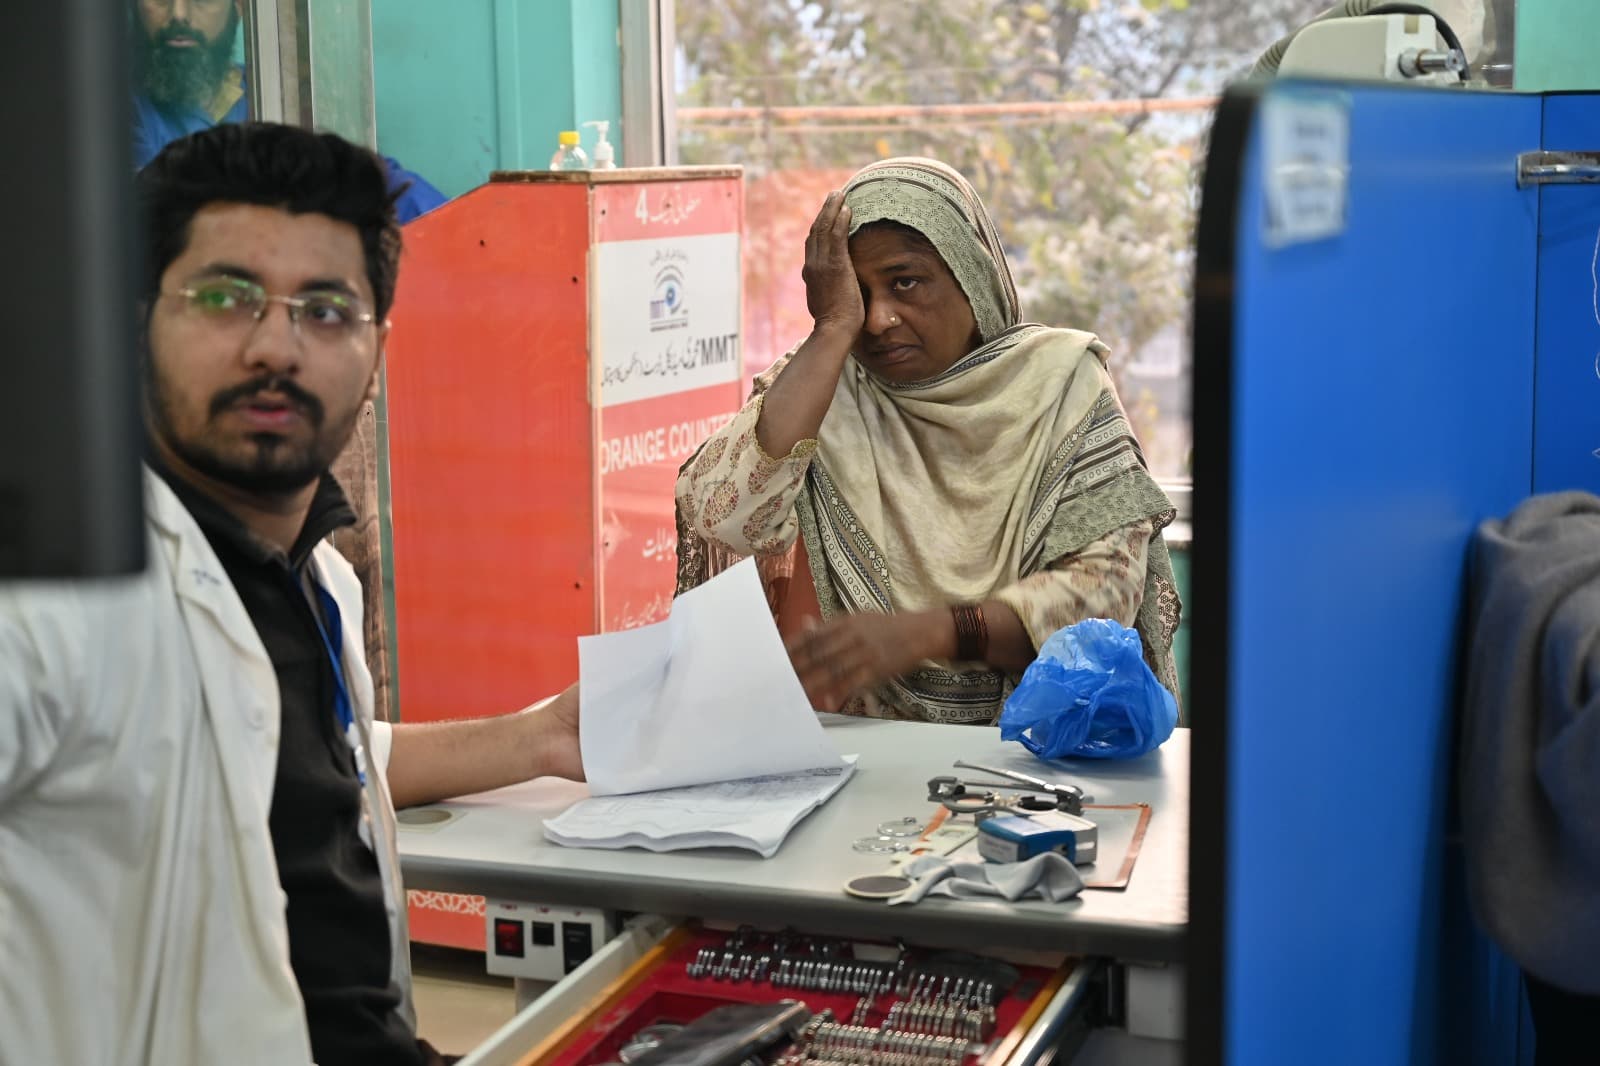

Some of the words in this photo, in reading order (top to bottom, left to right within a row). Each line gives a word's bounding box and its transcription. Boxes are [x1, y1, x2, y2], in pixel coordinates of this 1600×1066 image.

[635, 187, 648, 225] 4
[701, 333, 738, 367] MMT
[600, 428, 665, 475] ORANGE
